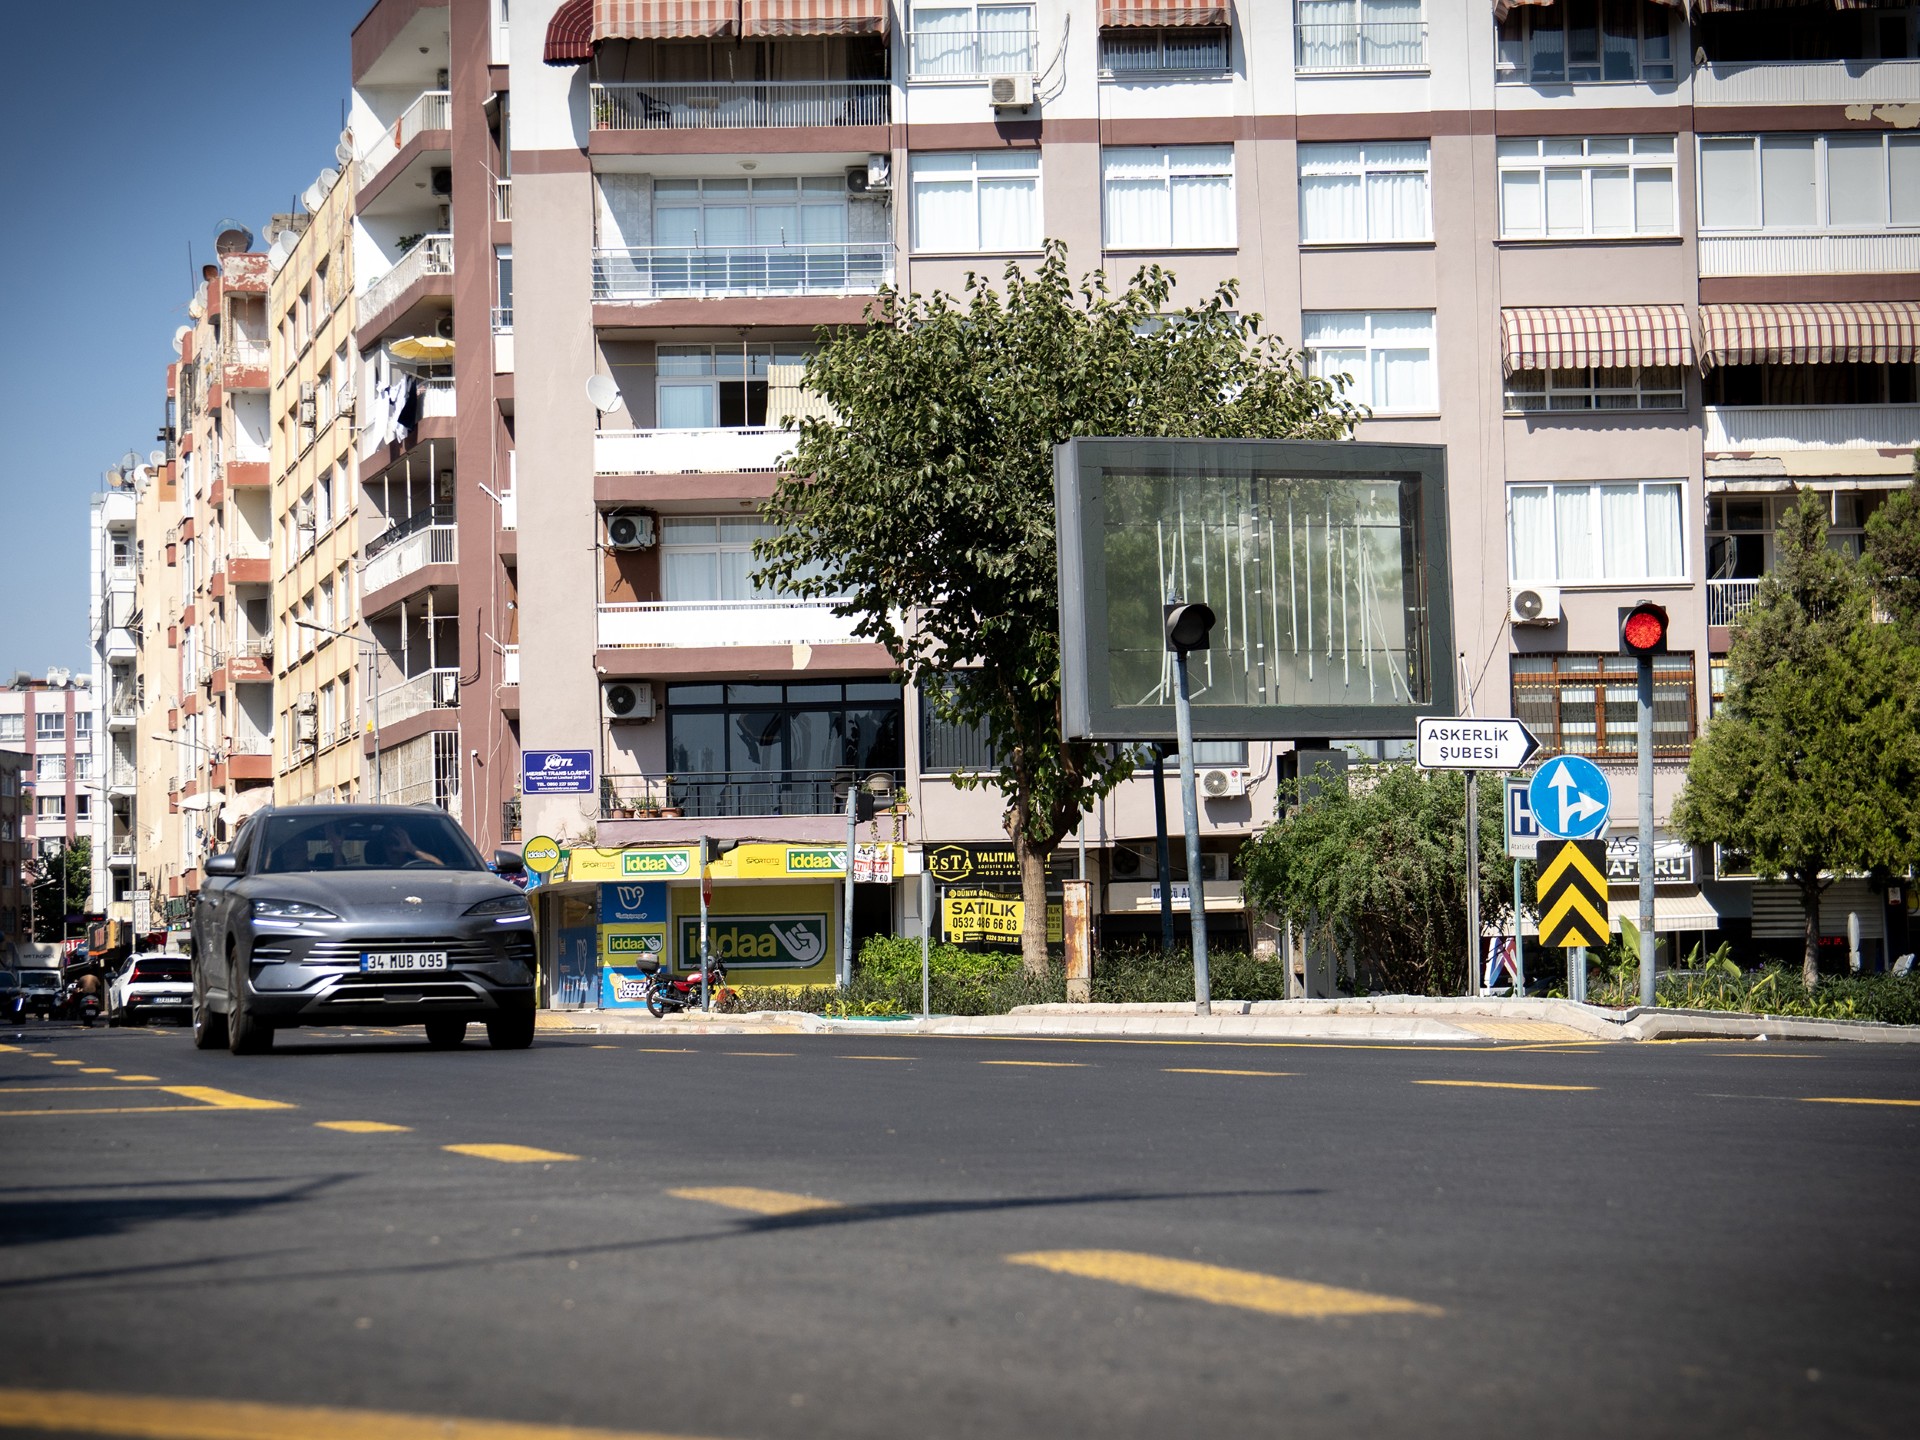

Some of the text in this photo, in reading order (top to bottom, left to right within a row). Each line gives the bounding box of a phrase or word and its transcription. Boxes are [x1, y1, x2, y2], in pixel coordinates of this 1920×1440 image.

[1428, 727, 1509, 741] ASKERLİK
[1440, 745, 1498, 761] ŞUBESİ
[626, 856, 667, 871] iddaa
[791, 853, 831, 868] iddaa
[976, 852, 1016, 862] YALITIM
[956, 889, 978, 897] DÜNYA
[951, 902, 1017, 917] SATILIK
[952, 917, 1017, 931] 0532 486 66 83
[611, 938, 645, 950] iddaa
[689, 927, 777, 958] iddaa
[954, 933, 961, 941] S
[369, 954, 443, 969] 34 MUB 095
